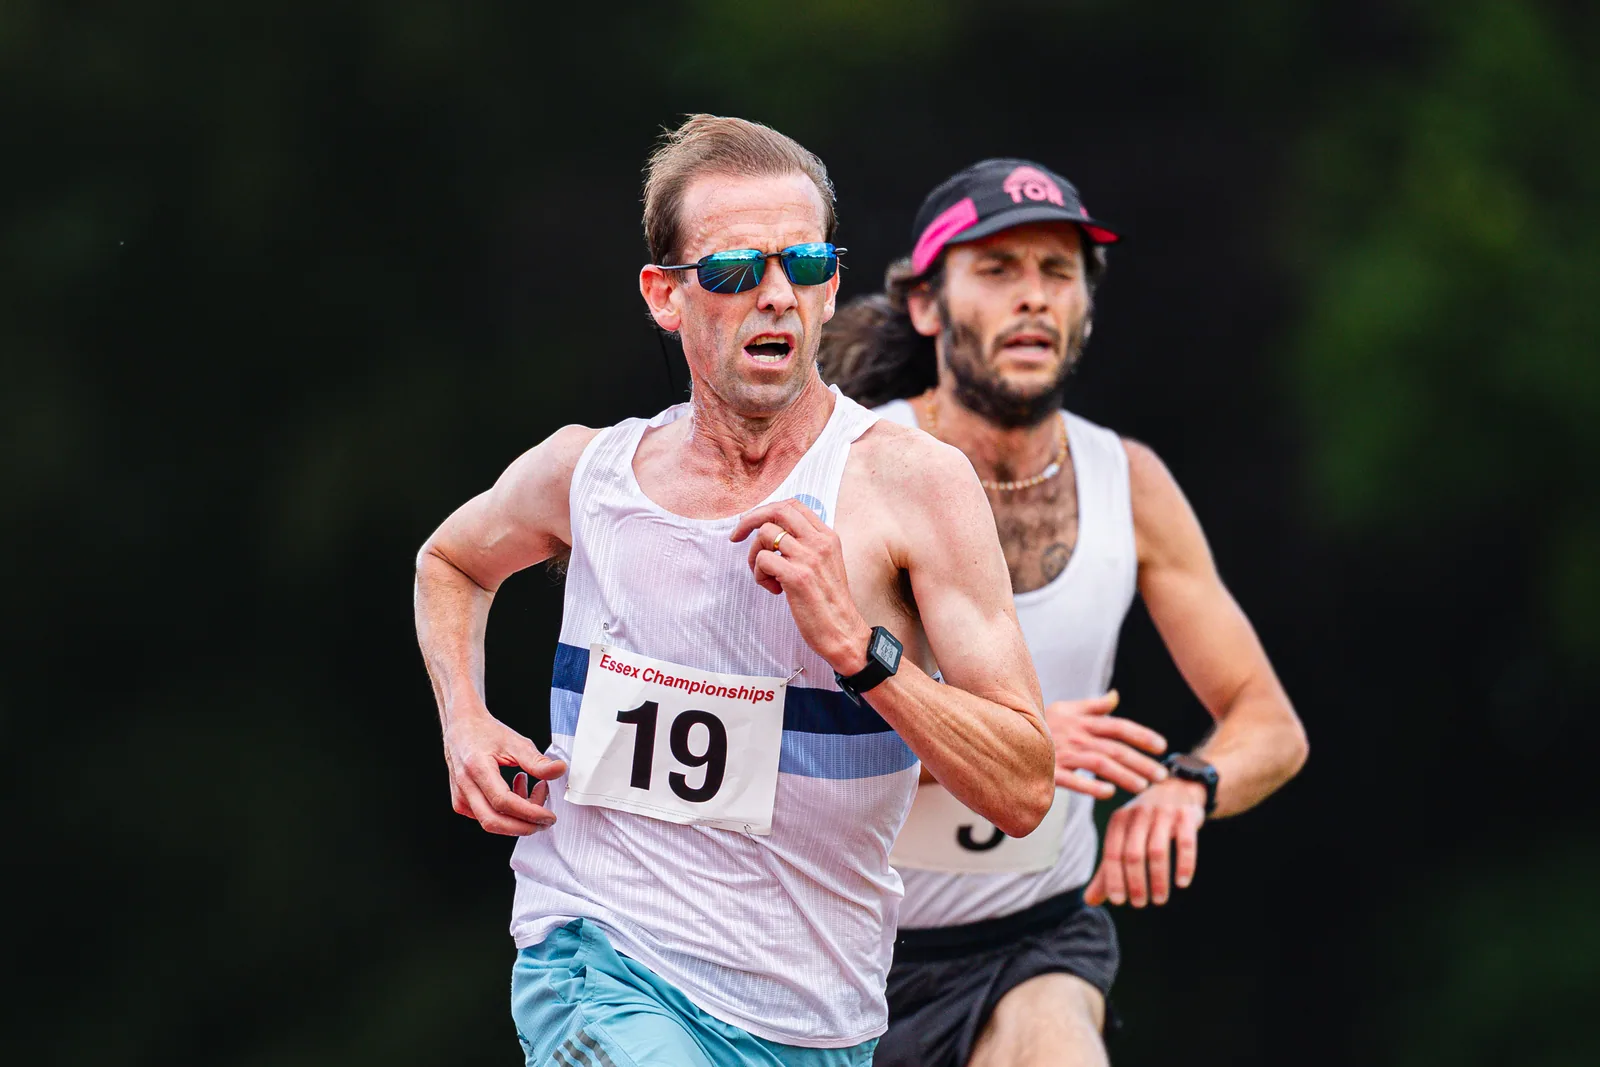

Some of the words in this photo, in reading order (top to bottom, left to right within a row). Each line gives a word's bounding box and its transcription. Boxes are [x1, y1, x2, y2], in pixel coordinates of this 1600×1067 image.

[599, 653, 641, 679] Essex
[641, 667, 775, 704] Championships
[616, 700, 728, 803] 19
